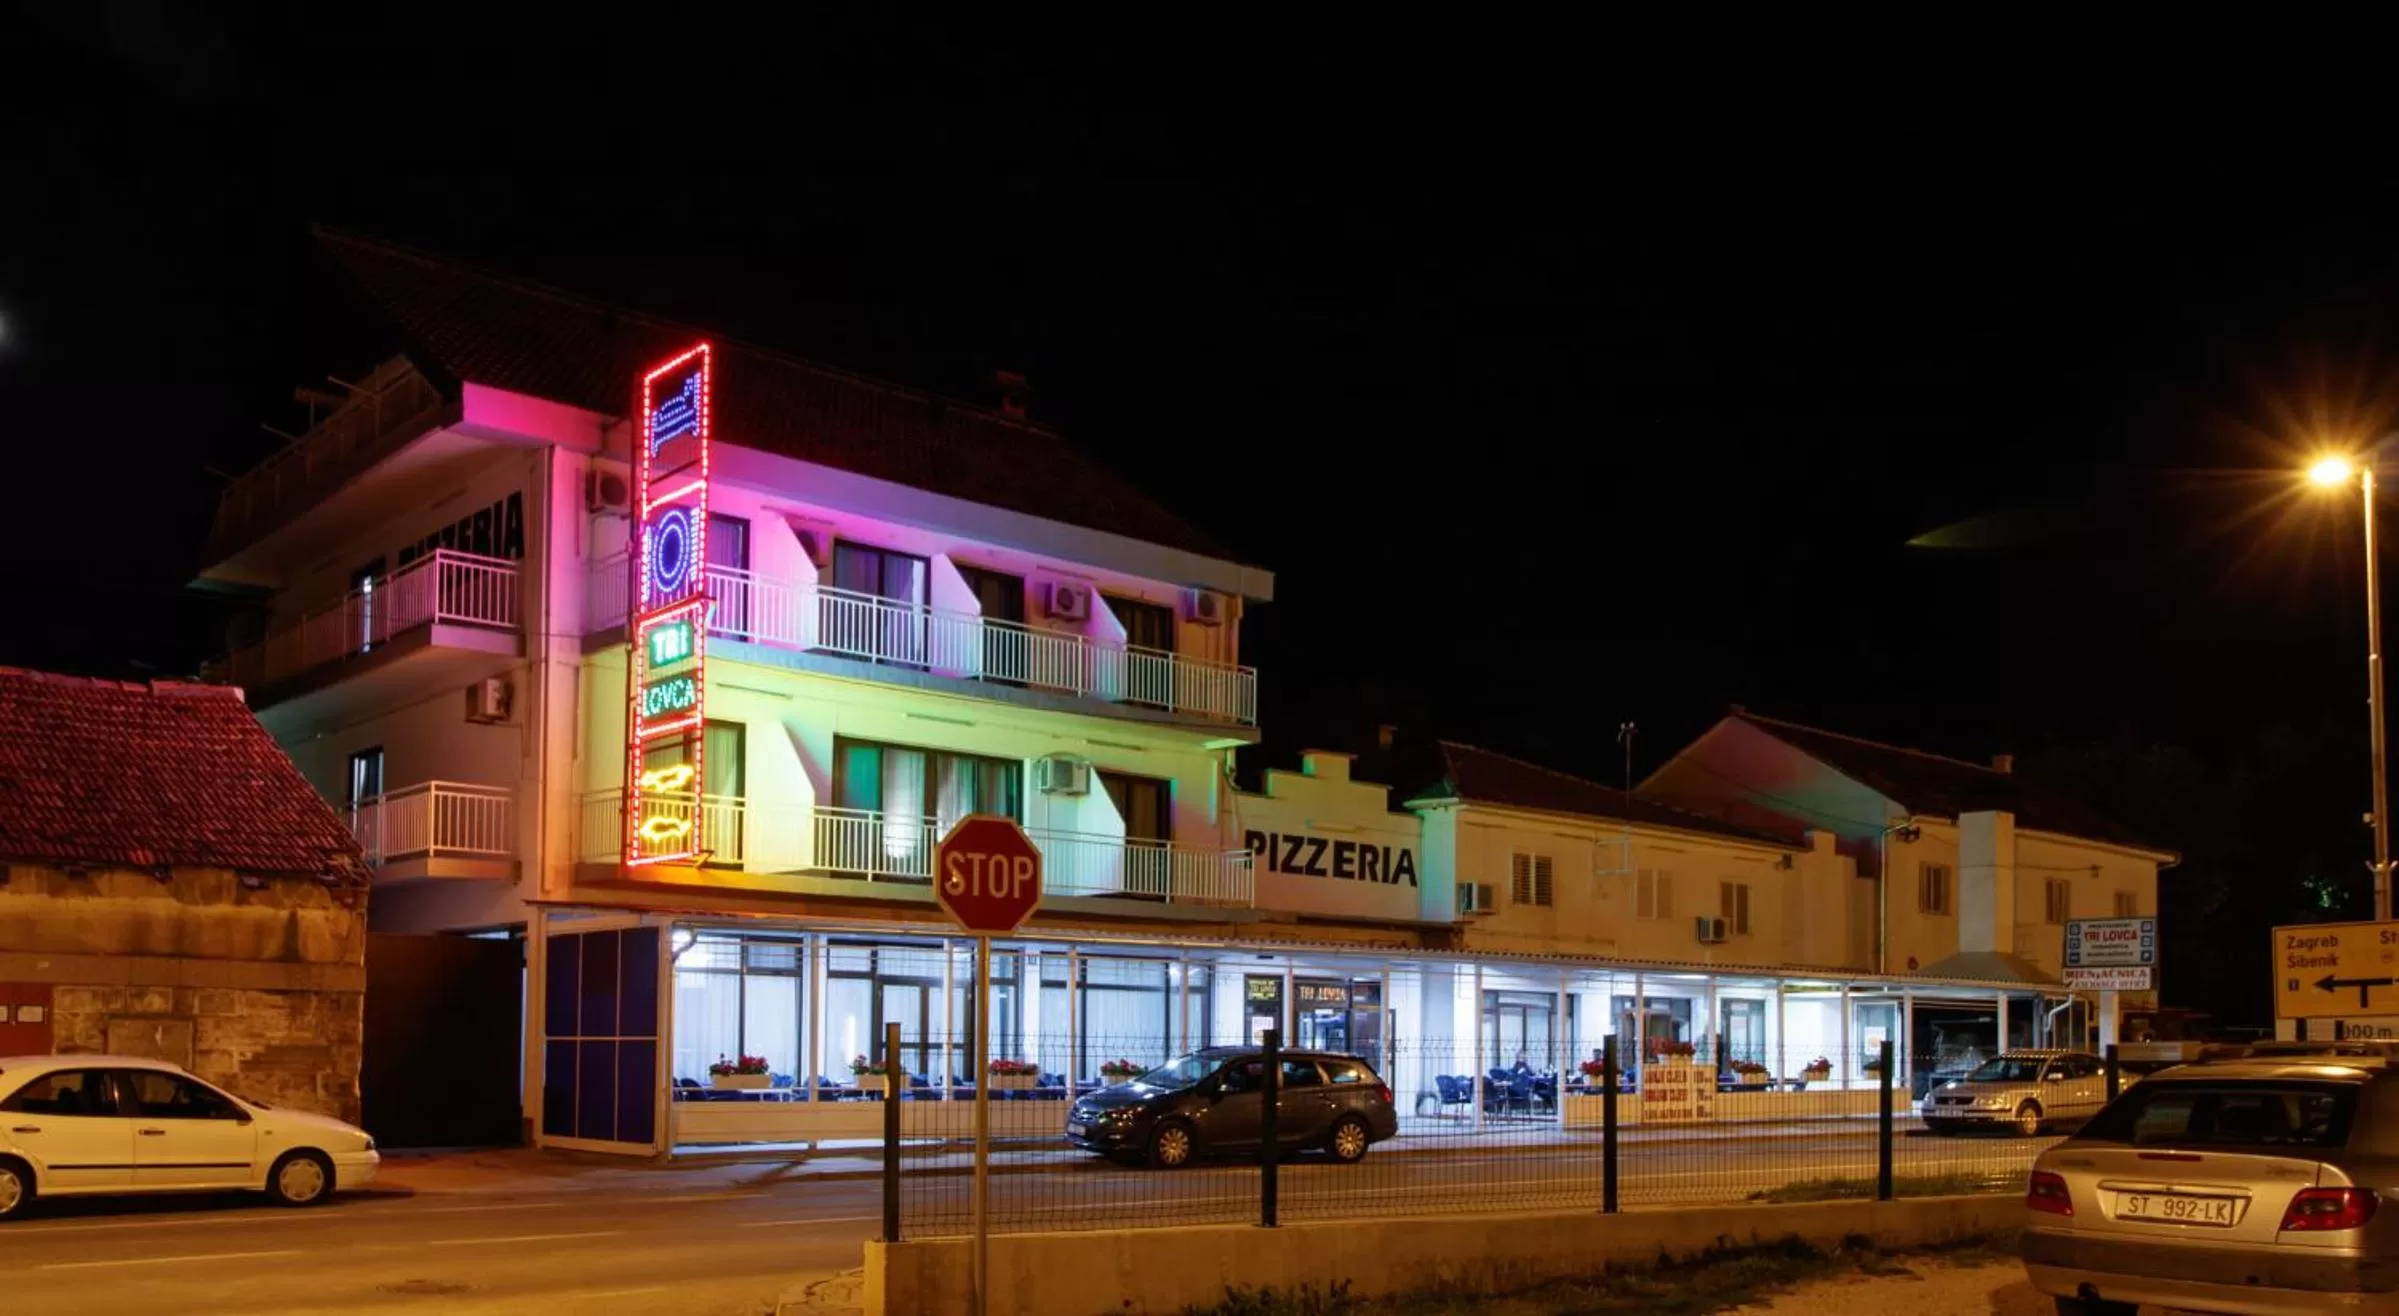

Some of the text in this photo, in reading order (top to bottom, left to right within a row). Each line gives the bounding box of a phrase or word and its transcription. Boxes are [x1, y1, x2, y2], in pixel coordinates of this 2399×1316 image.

[652, 624, 688, 663] TRI
[642, 679, 695, 717] LOVCA
[944, 850, 1034, 899] STOP
[1245, 830, 1418, 888] PIZZERIA
[2084, 928, 2138, 942] TRI LOVCA
[2287, 934, 2338, 952] Zagreb
[2128, 1196, 2227, 1220] ST 992-LK
